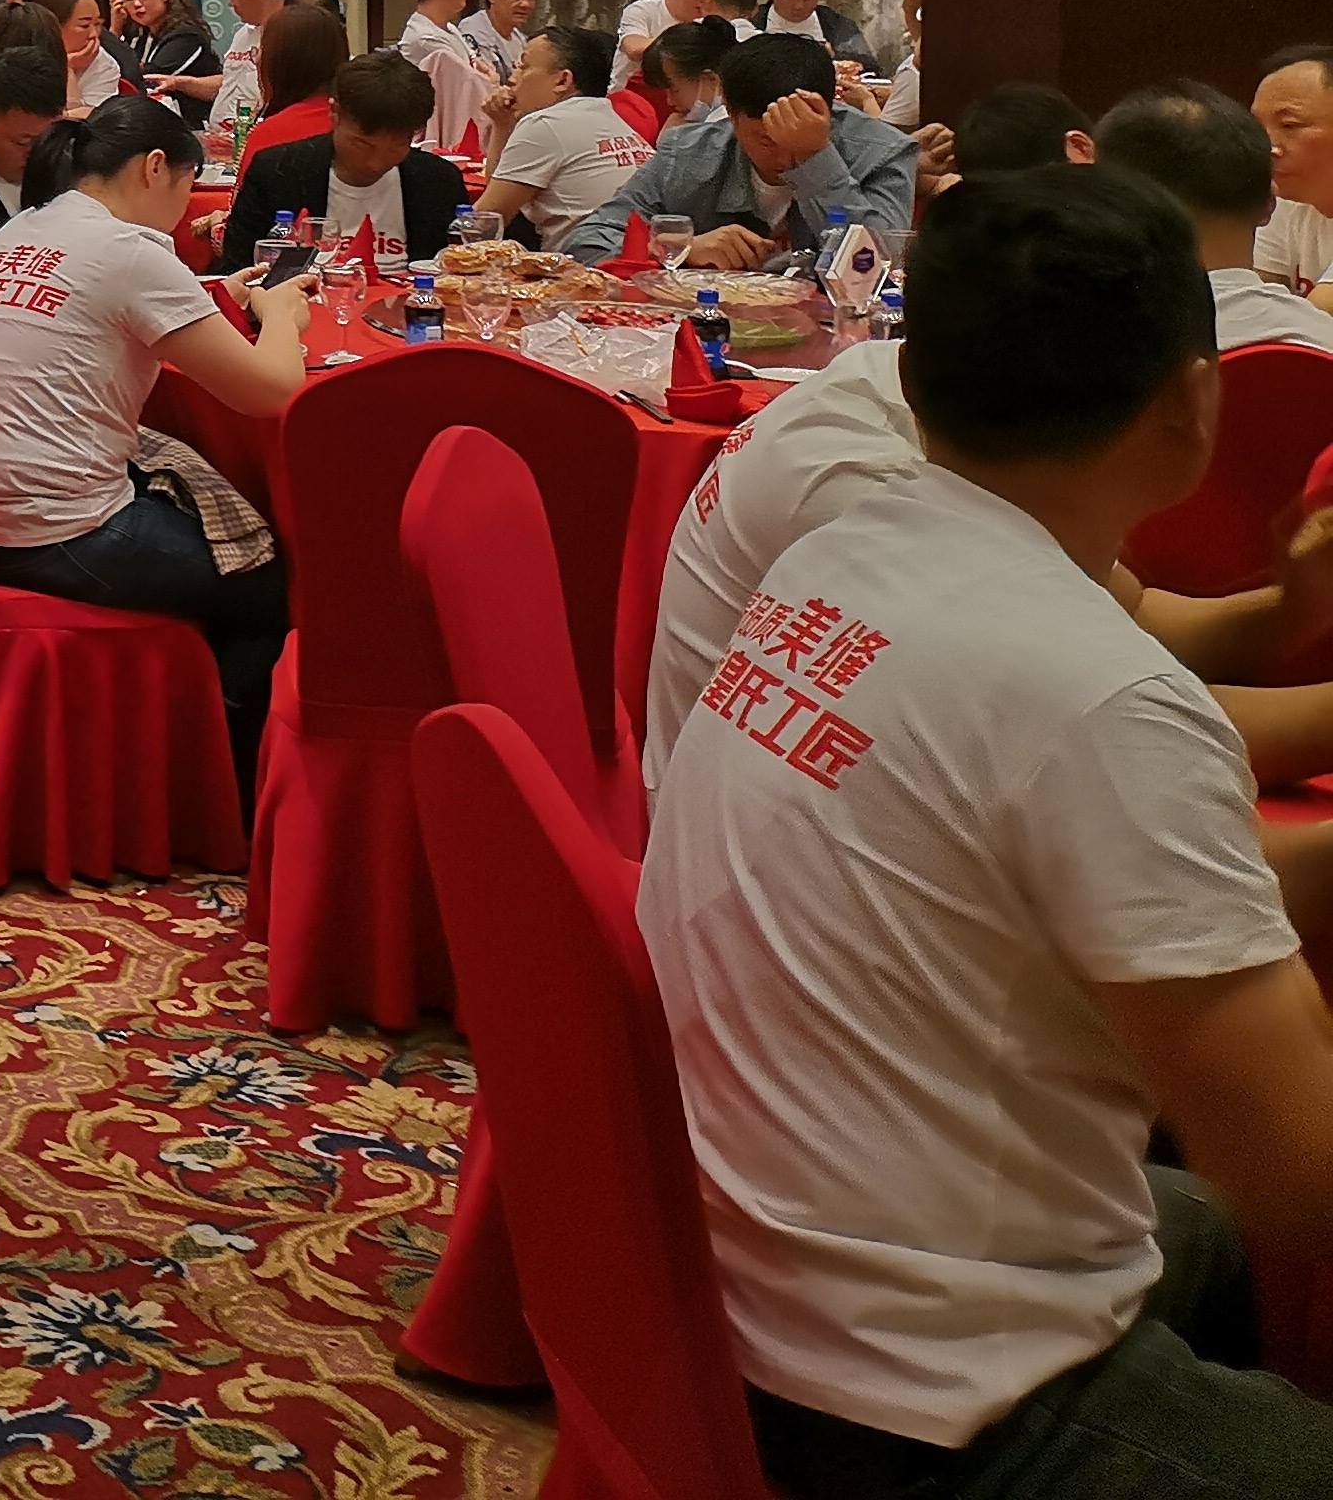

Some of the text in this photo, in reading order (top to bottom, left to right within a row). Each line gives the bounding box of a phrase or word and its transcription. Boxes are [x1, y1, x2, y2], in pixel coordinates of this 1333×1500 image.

[737, 589, 893, 700] 品质美缝
[699, 647, 876, 792] 皇氏工匠
